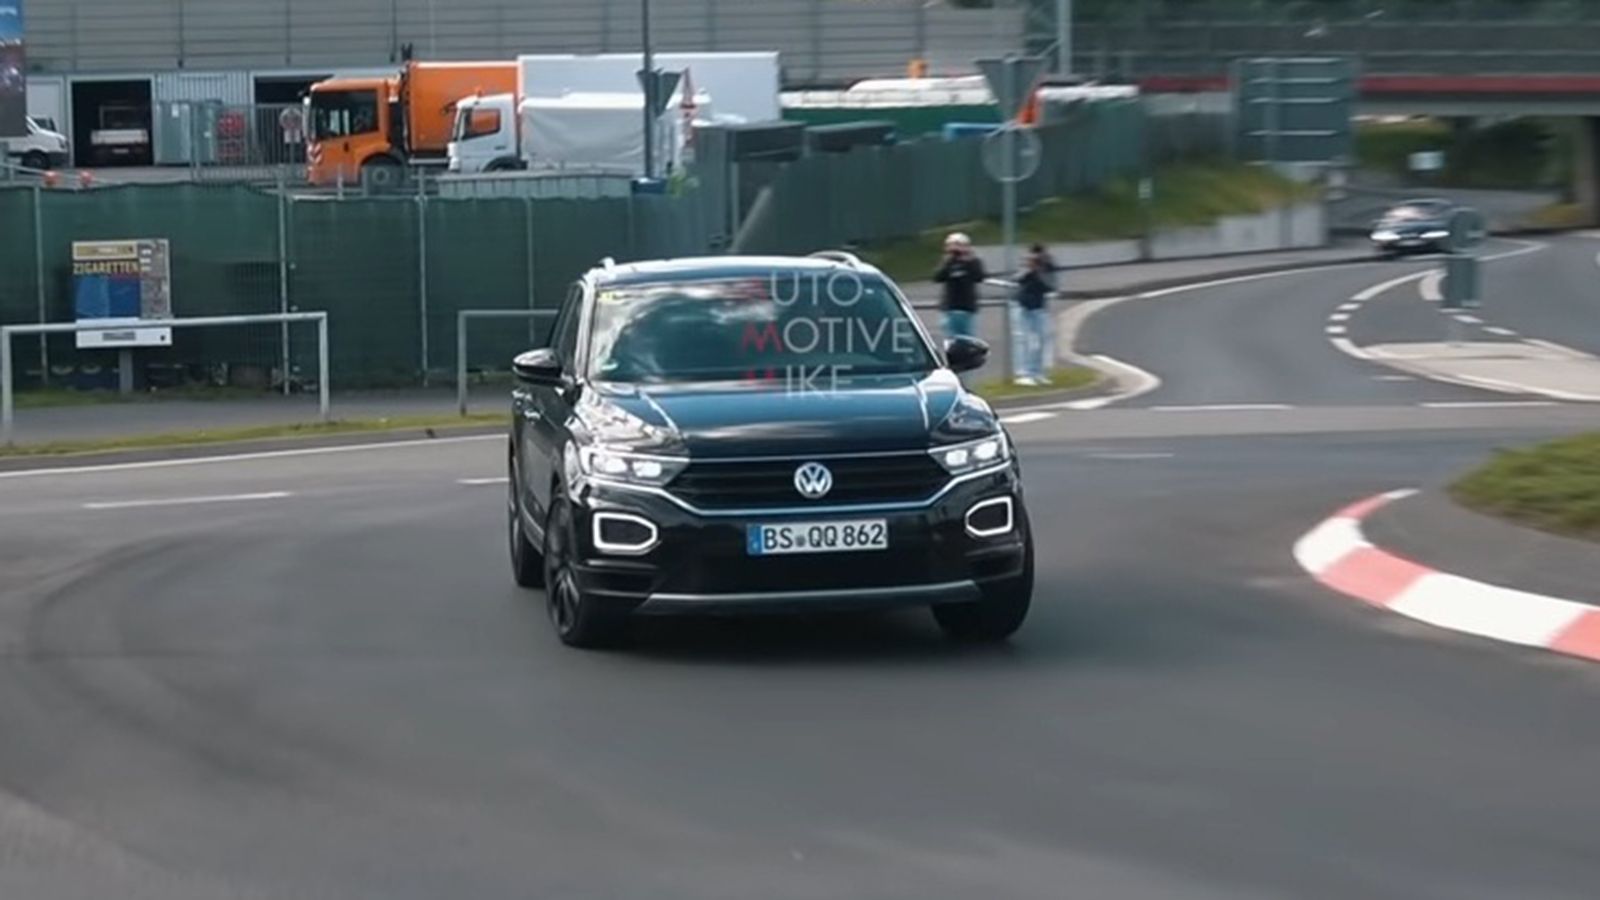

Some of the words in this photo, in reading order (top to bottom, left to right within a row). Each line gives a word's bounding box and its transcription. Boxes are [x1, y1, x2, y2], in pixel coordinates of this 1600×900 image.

[764, 527, 793, 549] BS
[808, 525, 838, 547] QQ
[843, 523, 883, 546] 862
